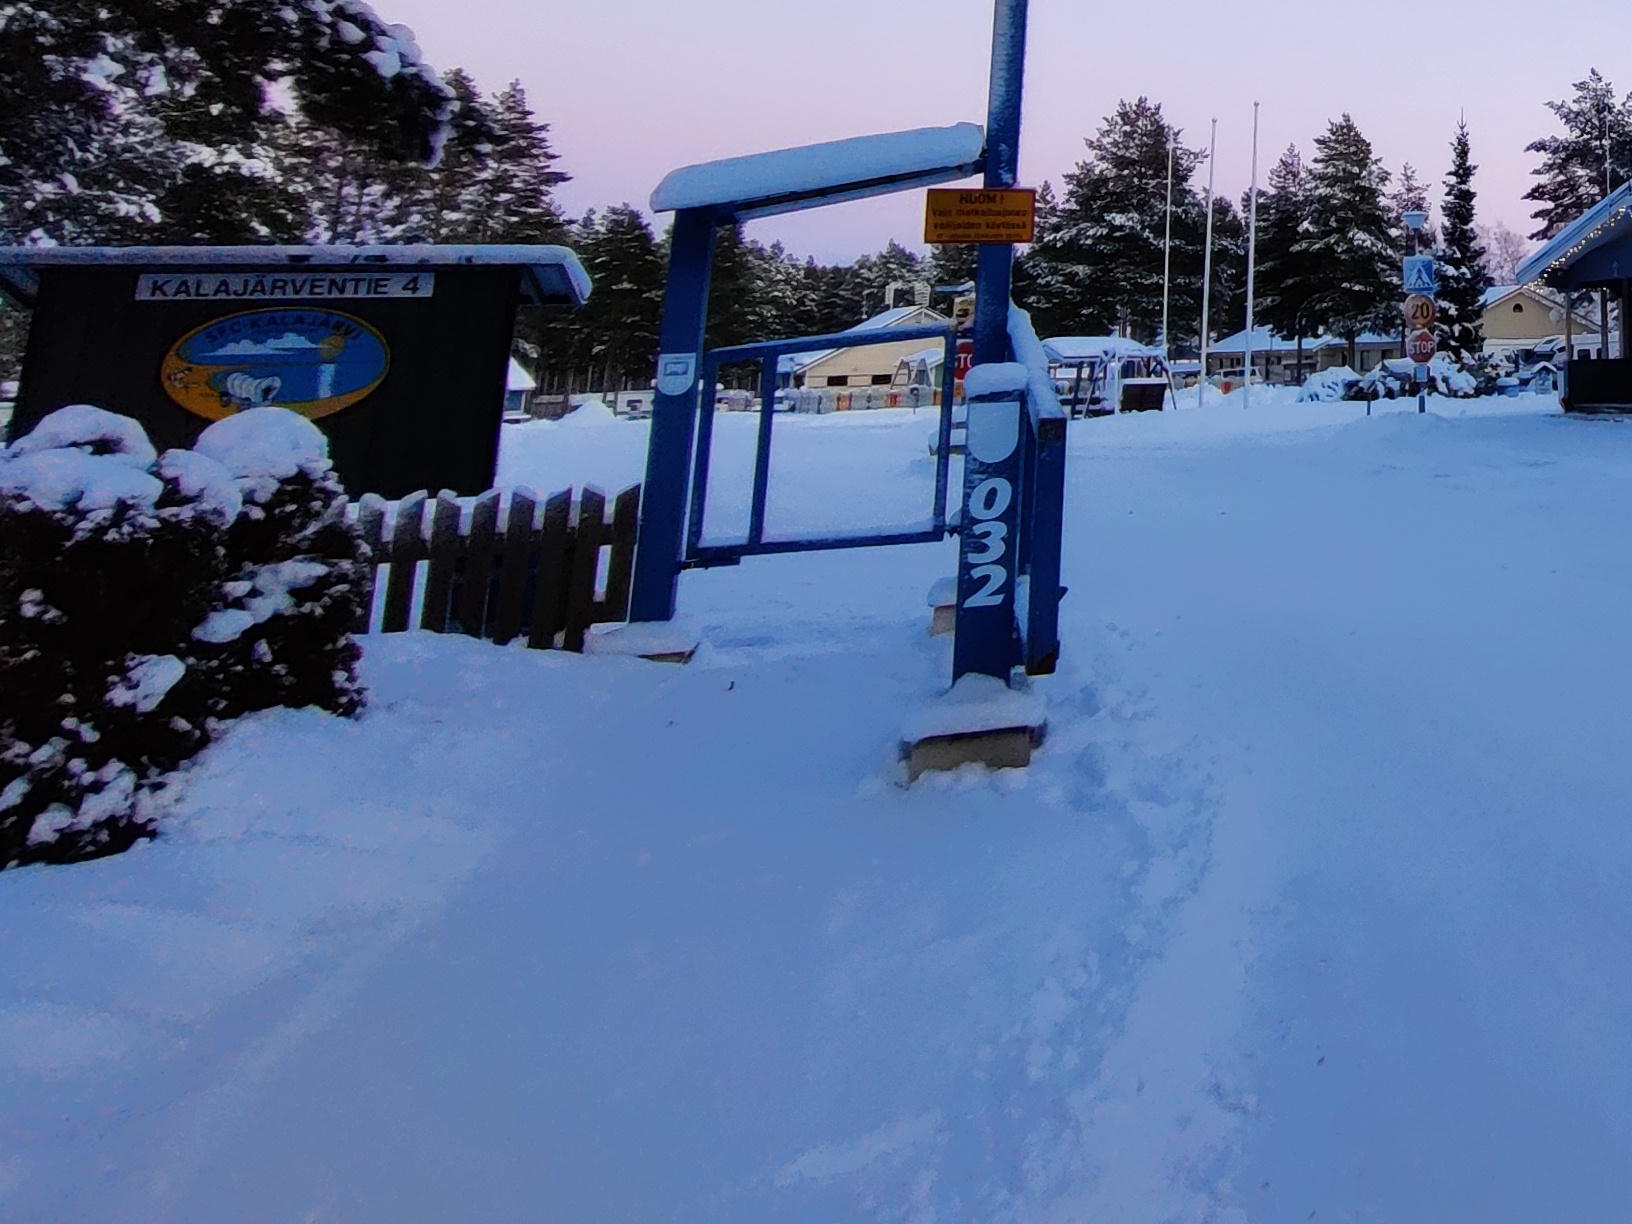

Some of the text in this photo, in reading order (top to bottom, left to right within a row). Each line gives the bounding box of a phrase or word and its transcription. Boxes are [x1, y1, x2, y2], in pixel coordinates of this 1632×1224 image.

[959, 193, 997, 204] HUOM
[151, 274, 421, 298] KALAJÄRVENTIE 4
[1411, 301, 1430, 320] 20
[1409, 340, 1434, 354] STOP
